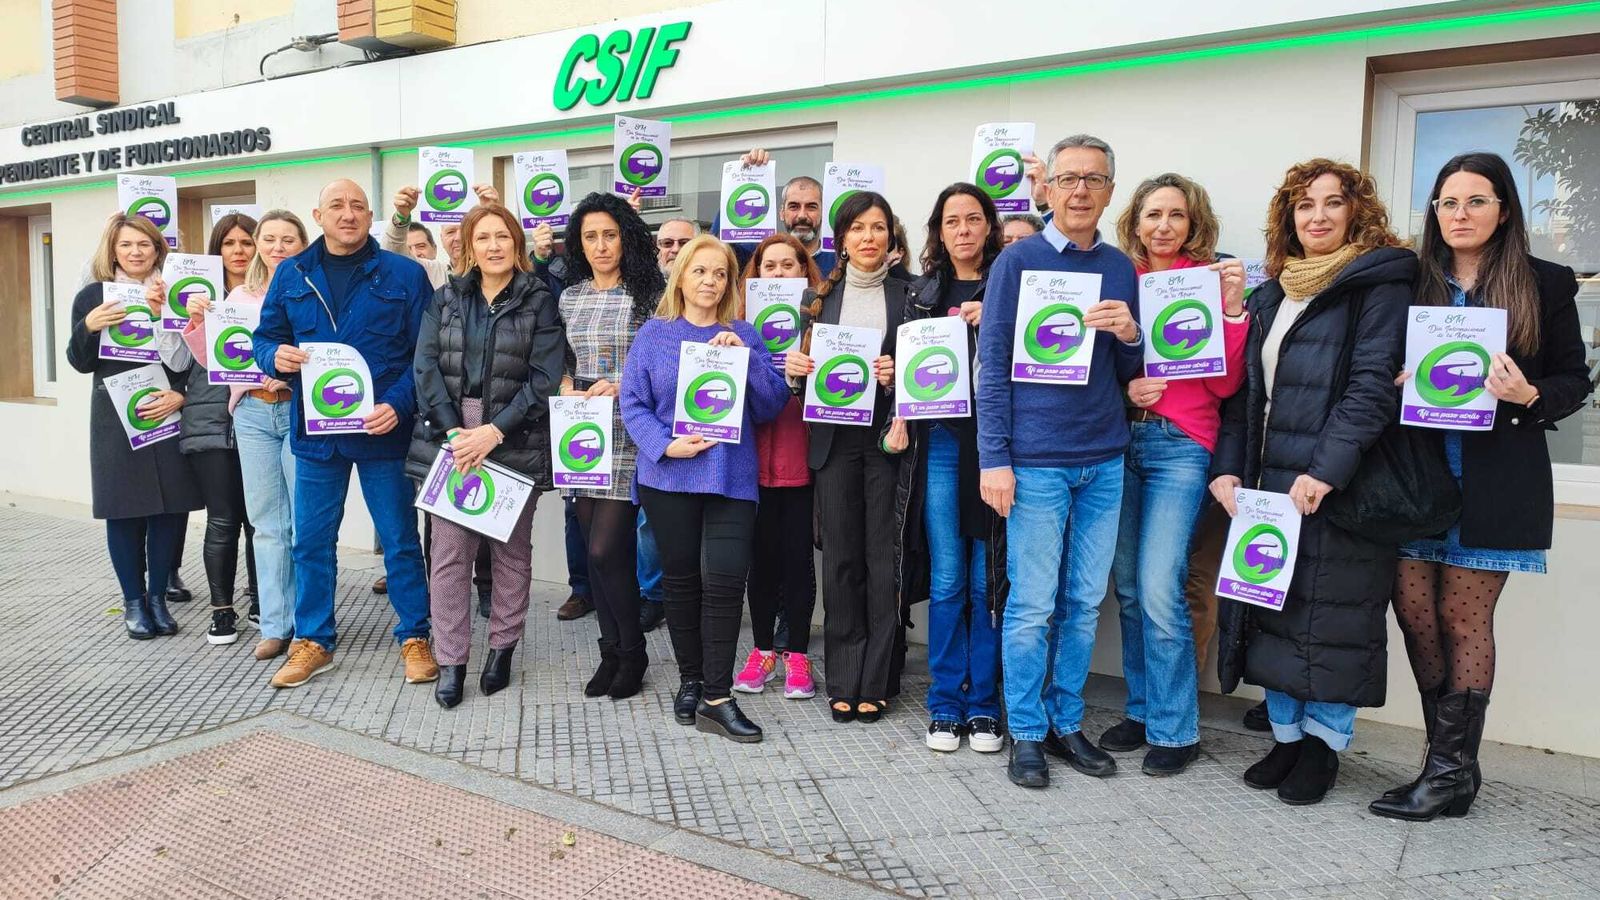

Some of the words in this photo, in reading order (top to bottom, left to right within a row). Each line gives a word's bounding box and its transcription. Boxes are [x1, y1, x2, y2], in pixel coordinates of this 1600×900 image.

[553, 21, 692, 111] CSIF
[21, 116, 94, 147] CENTRAL
[96, 101, 180, 135] SINDICAL
[635, 124, 646, 132] 8M
[81, 151, 95, 172] Y
[97, 147, 121, 171] DE
[124, 126, 271, 167] FUNCIONARIOS
[1049, 278, 1066, 287] 8M
[1168, 275, 1185, 285] 8M
[1445, 314, 1466, 324] 8M
[920, 325, 935, 334] 8M
[838, 332, 853, 340] 8M
[706, 350, 721, 358] 8M
[1026, 365, 1036, 375] Ni
[1157, 364, 1168, 373] Ni
[816, 408, 824, 416] Ni
[909, 404, 917, 413] Ni
[1417, 409, 1429, 419] Ni
[685, 424, 694, 432] Ni
[1256, 498, 1271, 507] 8M
[1230, 582, 1240, 592] Ni
